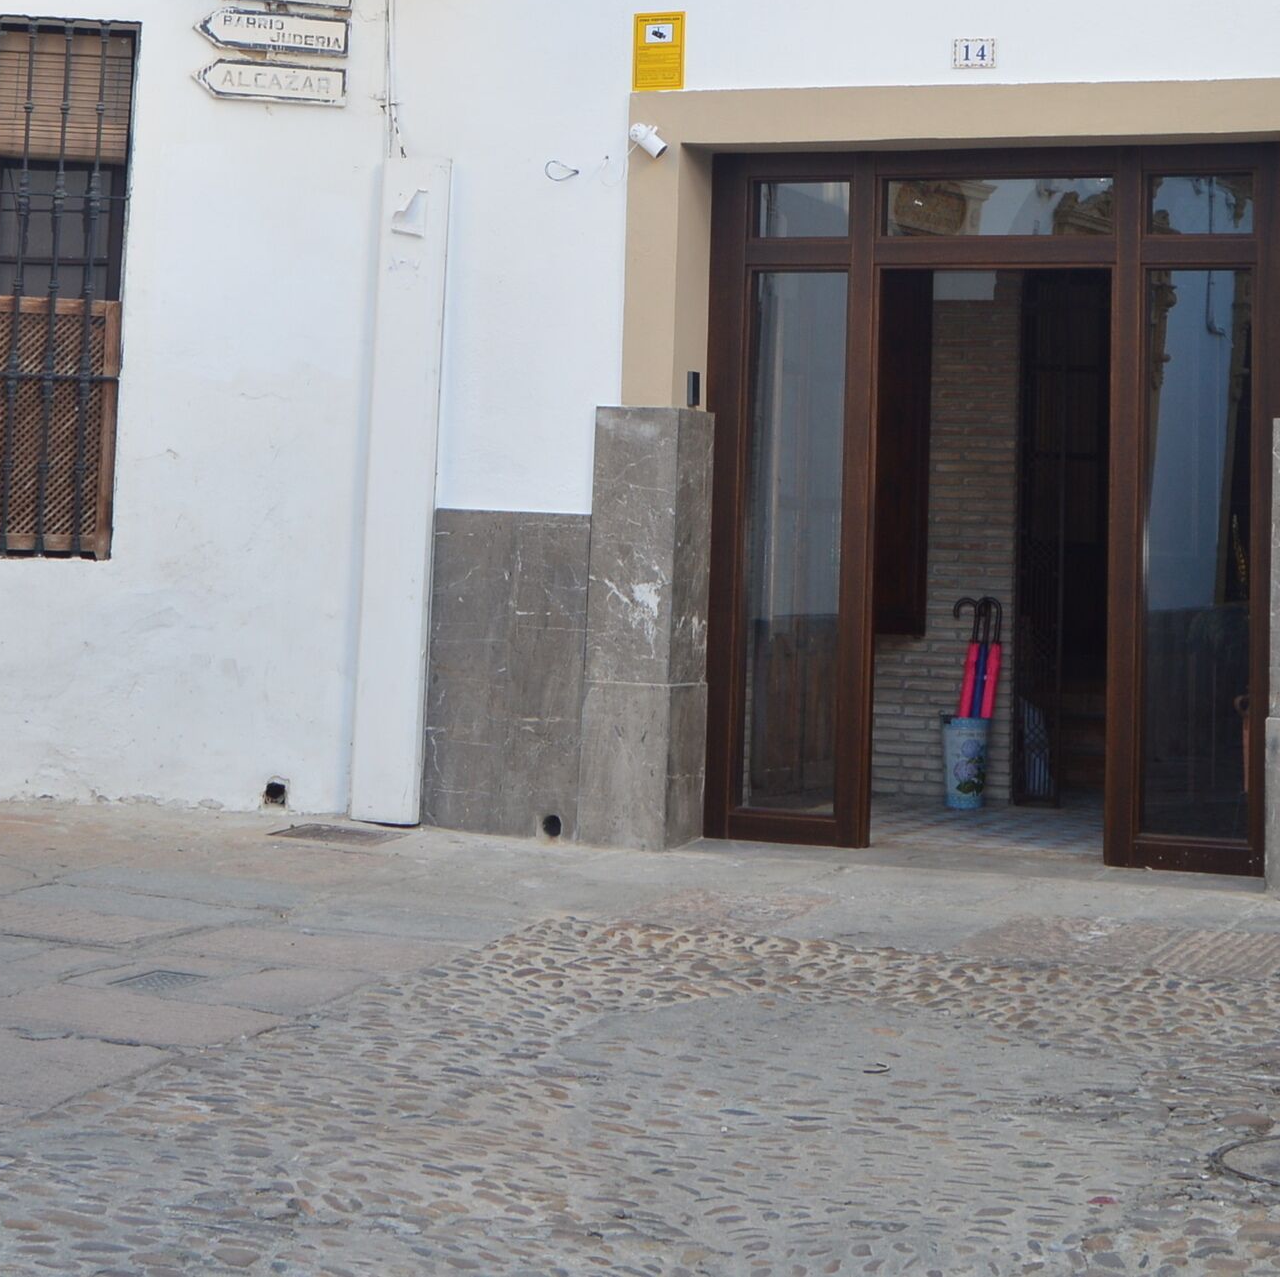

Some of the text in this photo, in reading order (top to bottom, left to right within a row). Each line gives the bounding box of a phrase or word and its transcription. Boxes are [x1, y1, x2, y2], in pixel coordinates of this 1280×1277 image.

[223, 15, 285, 31] BARRIO
[270, 31, 342, 49] JUDERIA
[962, 43, 987, 62] 14
[221, 69, 331, 95] ALCAZAR
